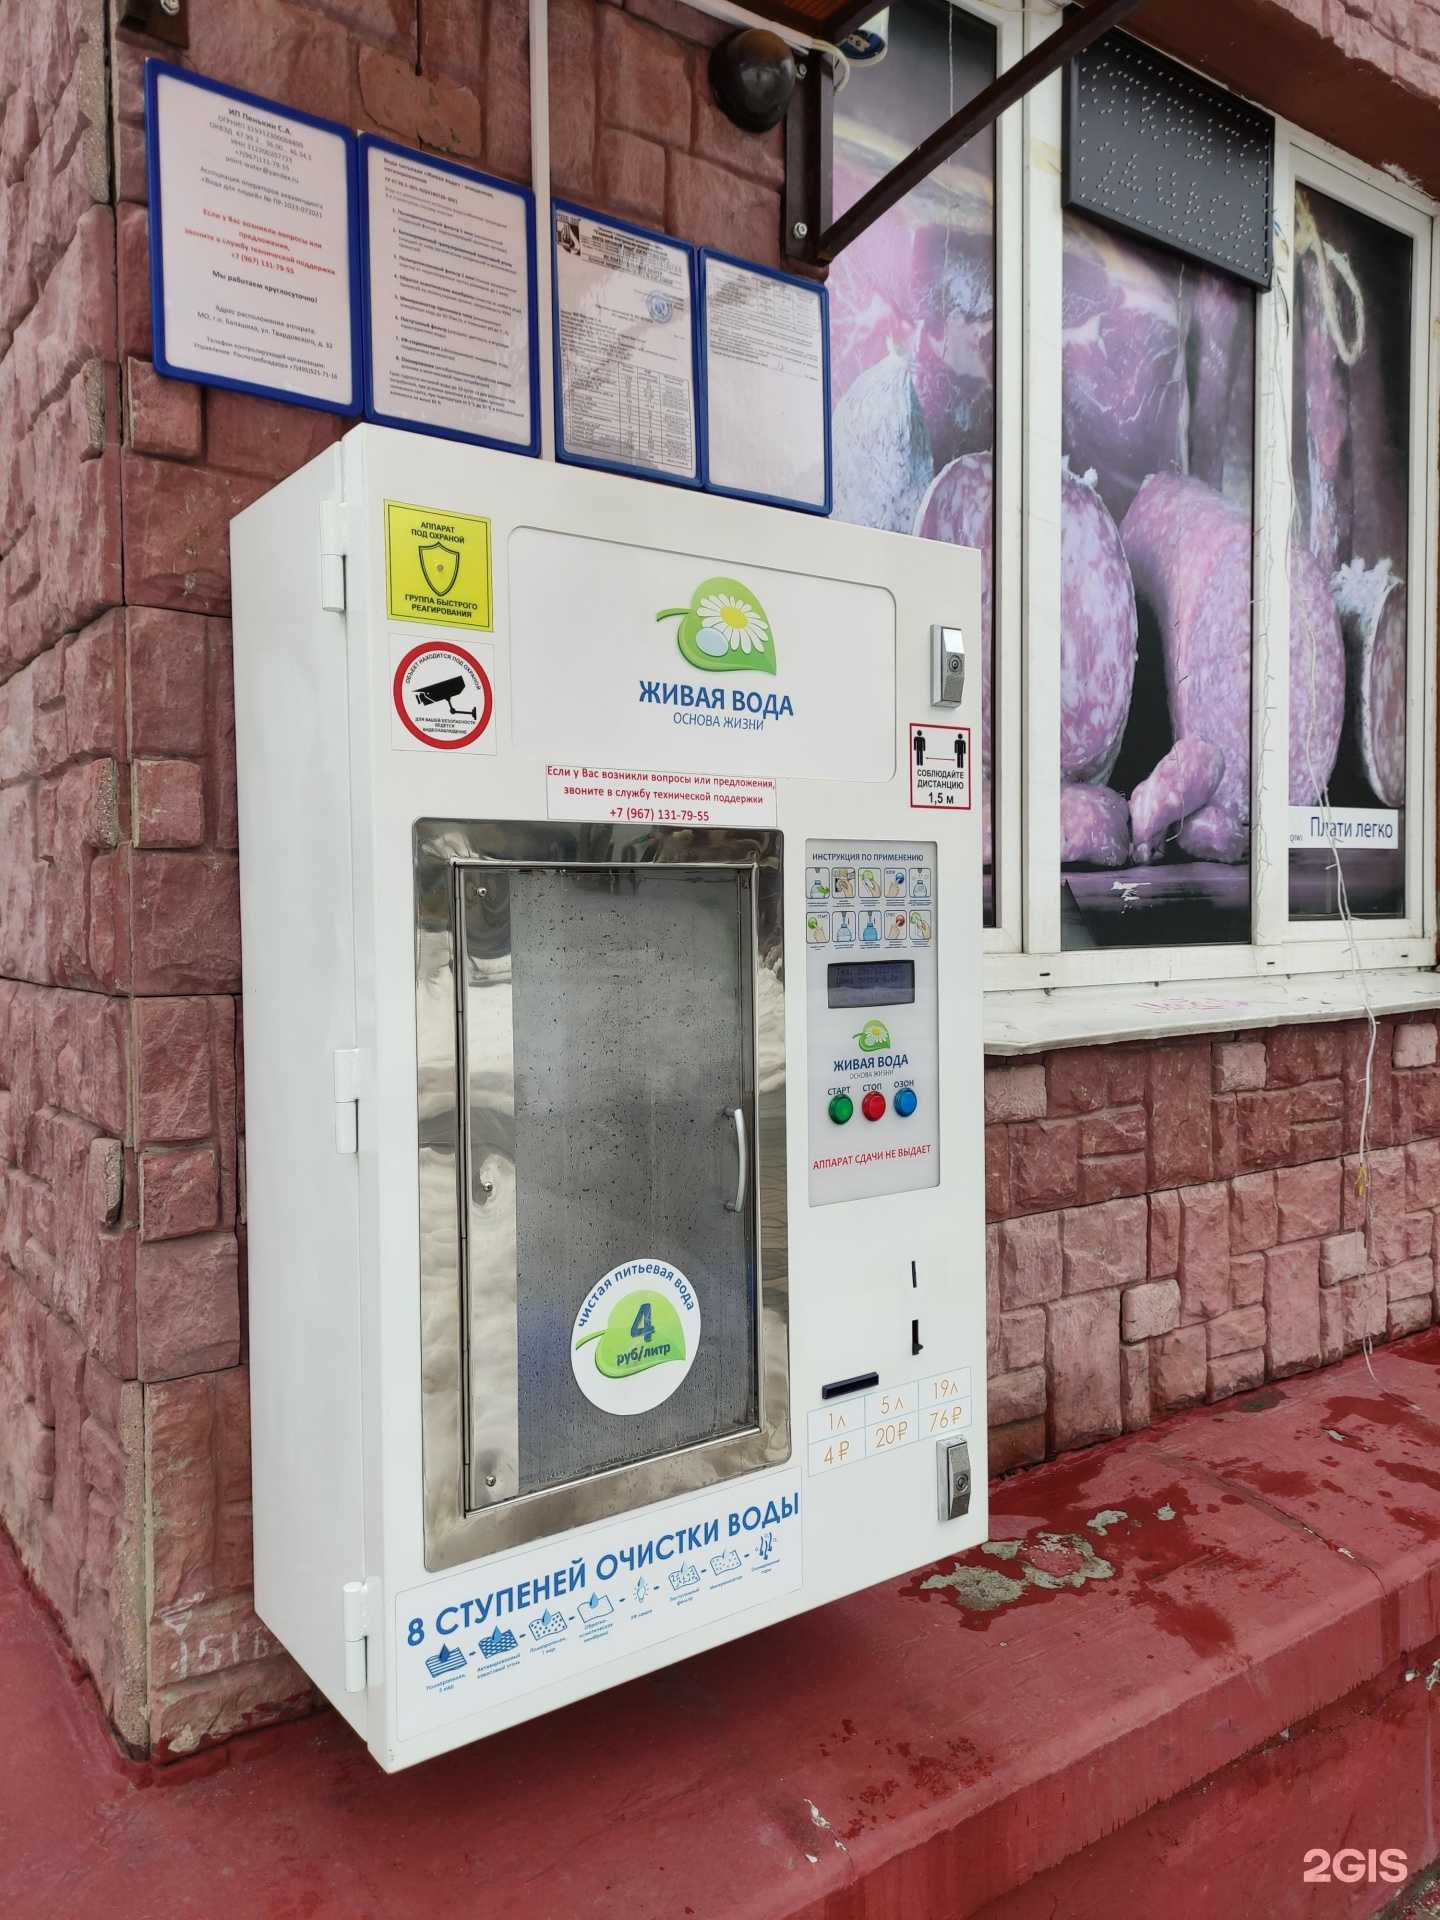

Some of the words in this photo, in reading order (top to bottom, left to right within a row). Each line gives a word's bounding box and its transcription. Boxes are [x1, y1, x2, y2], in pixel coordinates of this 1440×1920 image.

[228, 108, 240, 118] ИП
[203, 209, 220, 220] Если
[242, 221, 275, 234] возникли
[278, 231, 307, 245] вопросы
[310, 240, 321, 249] или
[222, 238, 247, 252] службу
[250, 246, 294, 263] технической
[212, 270, 225, 280] Мы
[228, 274, 262, 290] работаем
[264, 283, 317, 304] круглосуточно!
[215, 305, 234, 316] Адрес
[411, 528, 428, 540] ПОД
[429, 531, 465, 544] ОХРАНОЙ
[420, 521, 455, 533] АППАРАТ
[405, 593, 435, 605] ГРУППА
[436, 597, 478, 611] БЫСТРОГО
[411, 603, 472, 618] РЕАГИРОВАНИЯ
[405, 661, 421, 684] ОБЪЕКТ
[418, 652, 451, 668] НАХОДИТСЯ
[451, 655, 464, 667] ПОД
[462, 663, 481, 691] ОХРАНОЙ
[639, 680, 725, 710] ЖИВАЯ
[732, 690, 794, 720] ВОДА
[673, 711, 720, 728] ОСНОВА
[723, 715, 764, 731] ЖИЗНИ
[547, 765, 571, 777] Если
[573, 768, 579, 779] у
[582, 767, 599, 779] Вас
[601, 771, 648, 781] возникли
[651, 773, 691, 786] вопросы
[694, 775, 711, 784] или
[713, 777, 775, 789] предложения,
[917, 767, 964, 779] СОБЛЮДАЙТЕ
[917, 778, 964, 790] ДИСТАНЦИЮ
[564, 785, 604, 796] звоните
[607, 788, 613, 797] в
[615, 787, 651, 801] службу
[653, 789, 711, 801] технической
[713, 793, 763, 806] поддержки
[928, 792, 943, 805] 1,5
[609, 808, 623, 818] +7
[626, 807, 654, 821] (967)
[658, 809, 709, 821] 131-79-55
[1310, 816, 1352, 838] Плати
[1355, 822, 1393, 839] легко
[812, 853, 860, 862] ИНСТРУКЦИЯ
[873, 853, 924, 861] ПРИМЕНЕНИЮ
[833, 1057, 875, 1073] ЖИВАЯ
[878, 1054, 909, 1069] ВОДА
[827, 1086, 851, 1096] СТАРТ
[862, 1083, 882, 1092] СТОП
[893, 1079, 914, 1089] ОЗОН
[812, 1155, 853, 1170] АППАРАТ
[855, 1150, 884, 1165] СДАЧИ
[885, 1150, 896, 1159] НЕ
[897, 1144, 932, 1158] ВЫДАЕТ
[578, 1278, 613, 1328] чистая
[615, 1263, 675, 1282] питьевая
[674, 1278, 695, 1311] вода
[630, 1302, 656, 1343] 4
[616, 1343, 671, 1366] руб/литр
[407, 1617, 425, 1647] 8
[435, 1557, 586, 1636] СТУПЕНЕЙ
[596, 1518, 719, 1580] ОЧИСТКИ
[728, 1492, 799, 1537] ВОДЫ
